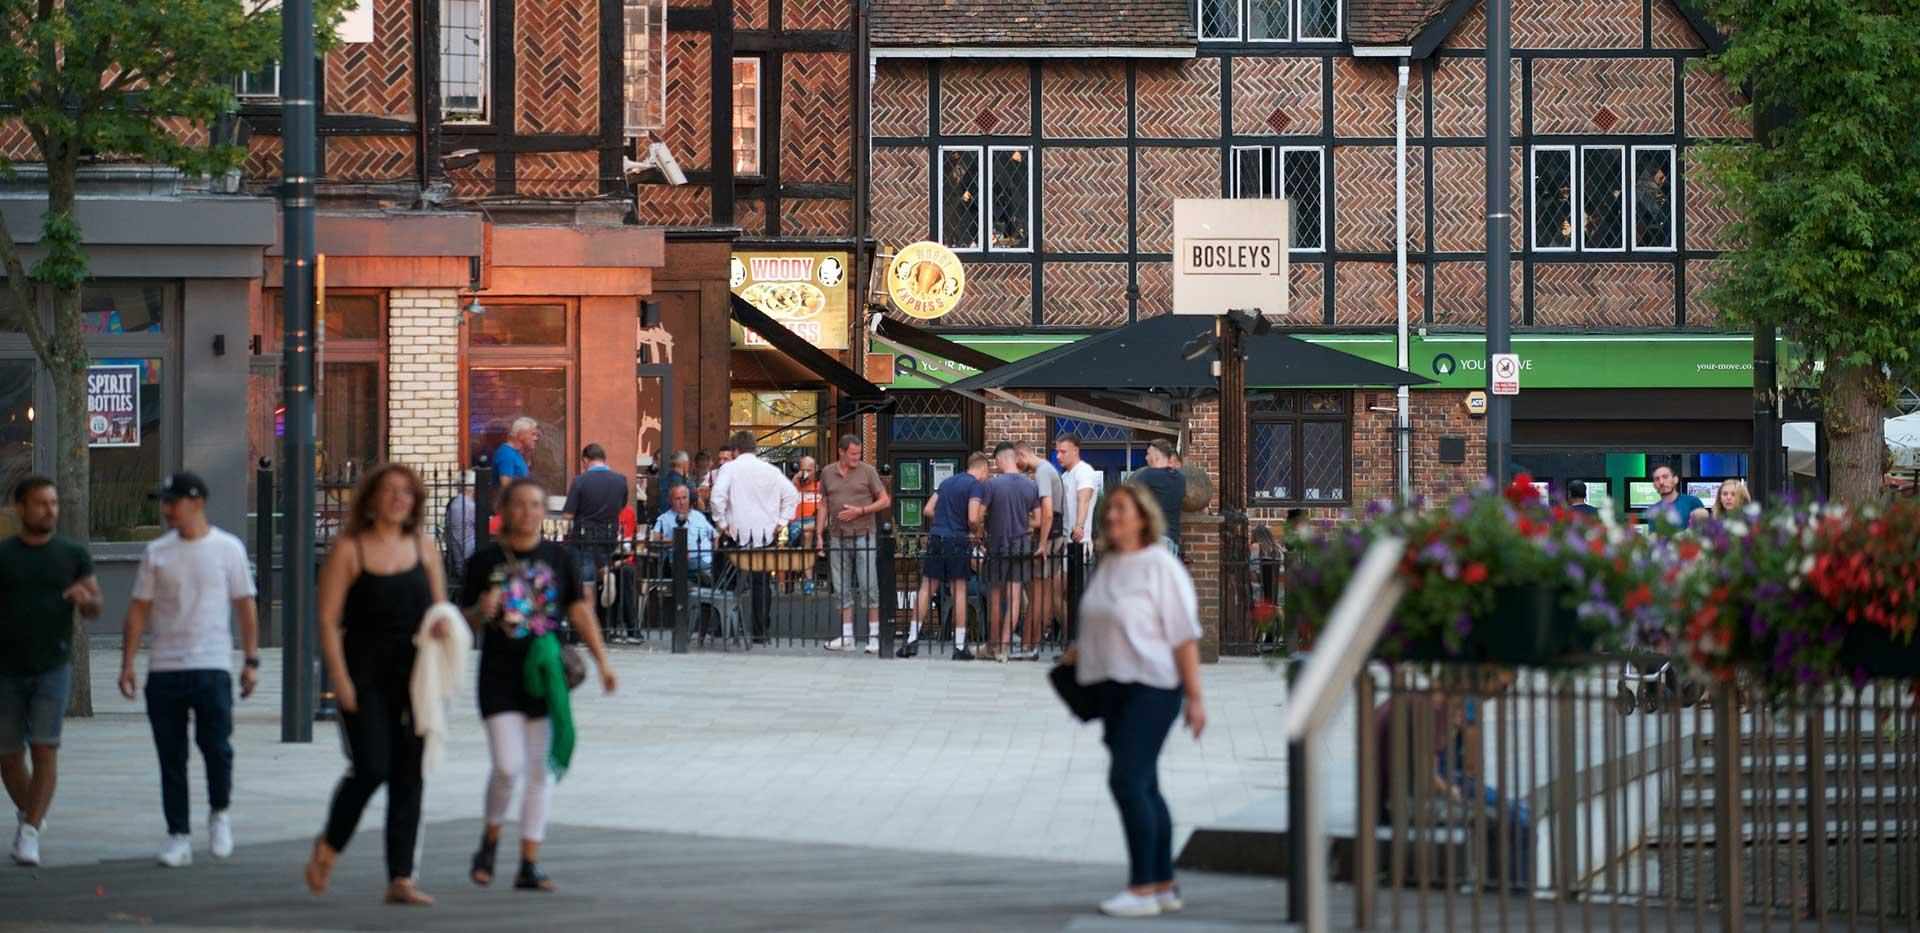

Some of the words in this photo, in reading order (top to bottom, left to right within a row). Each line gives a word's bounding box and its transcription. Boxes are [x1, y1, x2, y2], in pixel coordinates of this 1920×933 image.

[1193, 245, 1270, 268] BOSLEYS
[750, 258, 813, 280] WOODY
[1460, 360, 1486, 370] YOU
[88, 374, 133, 393] SPIRIT
[88, 395, 133, 412] BOTTLES
